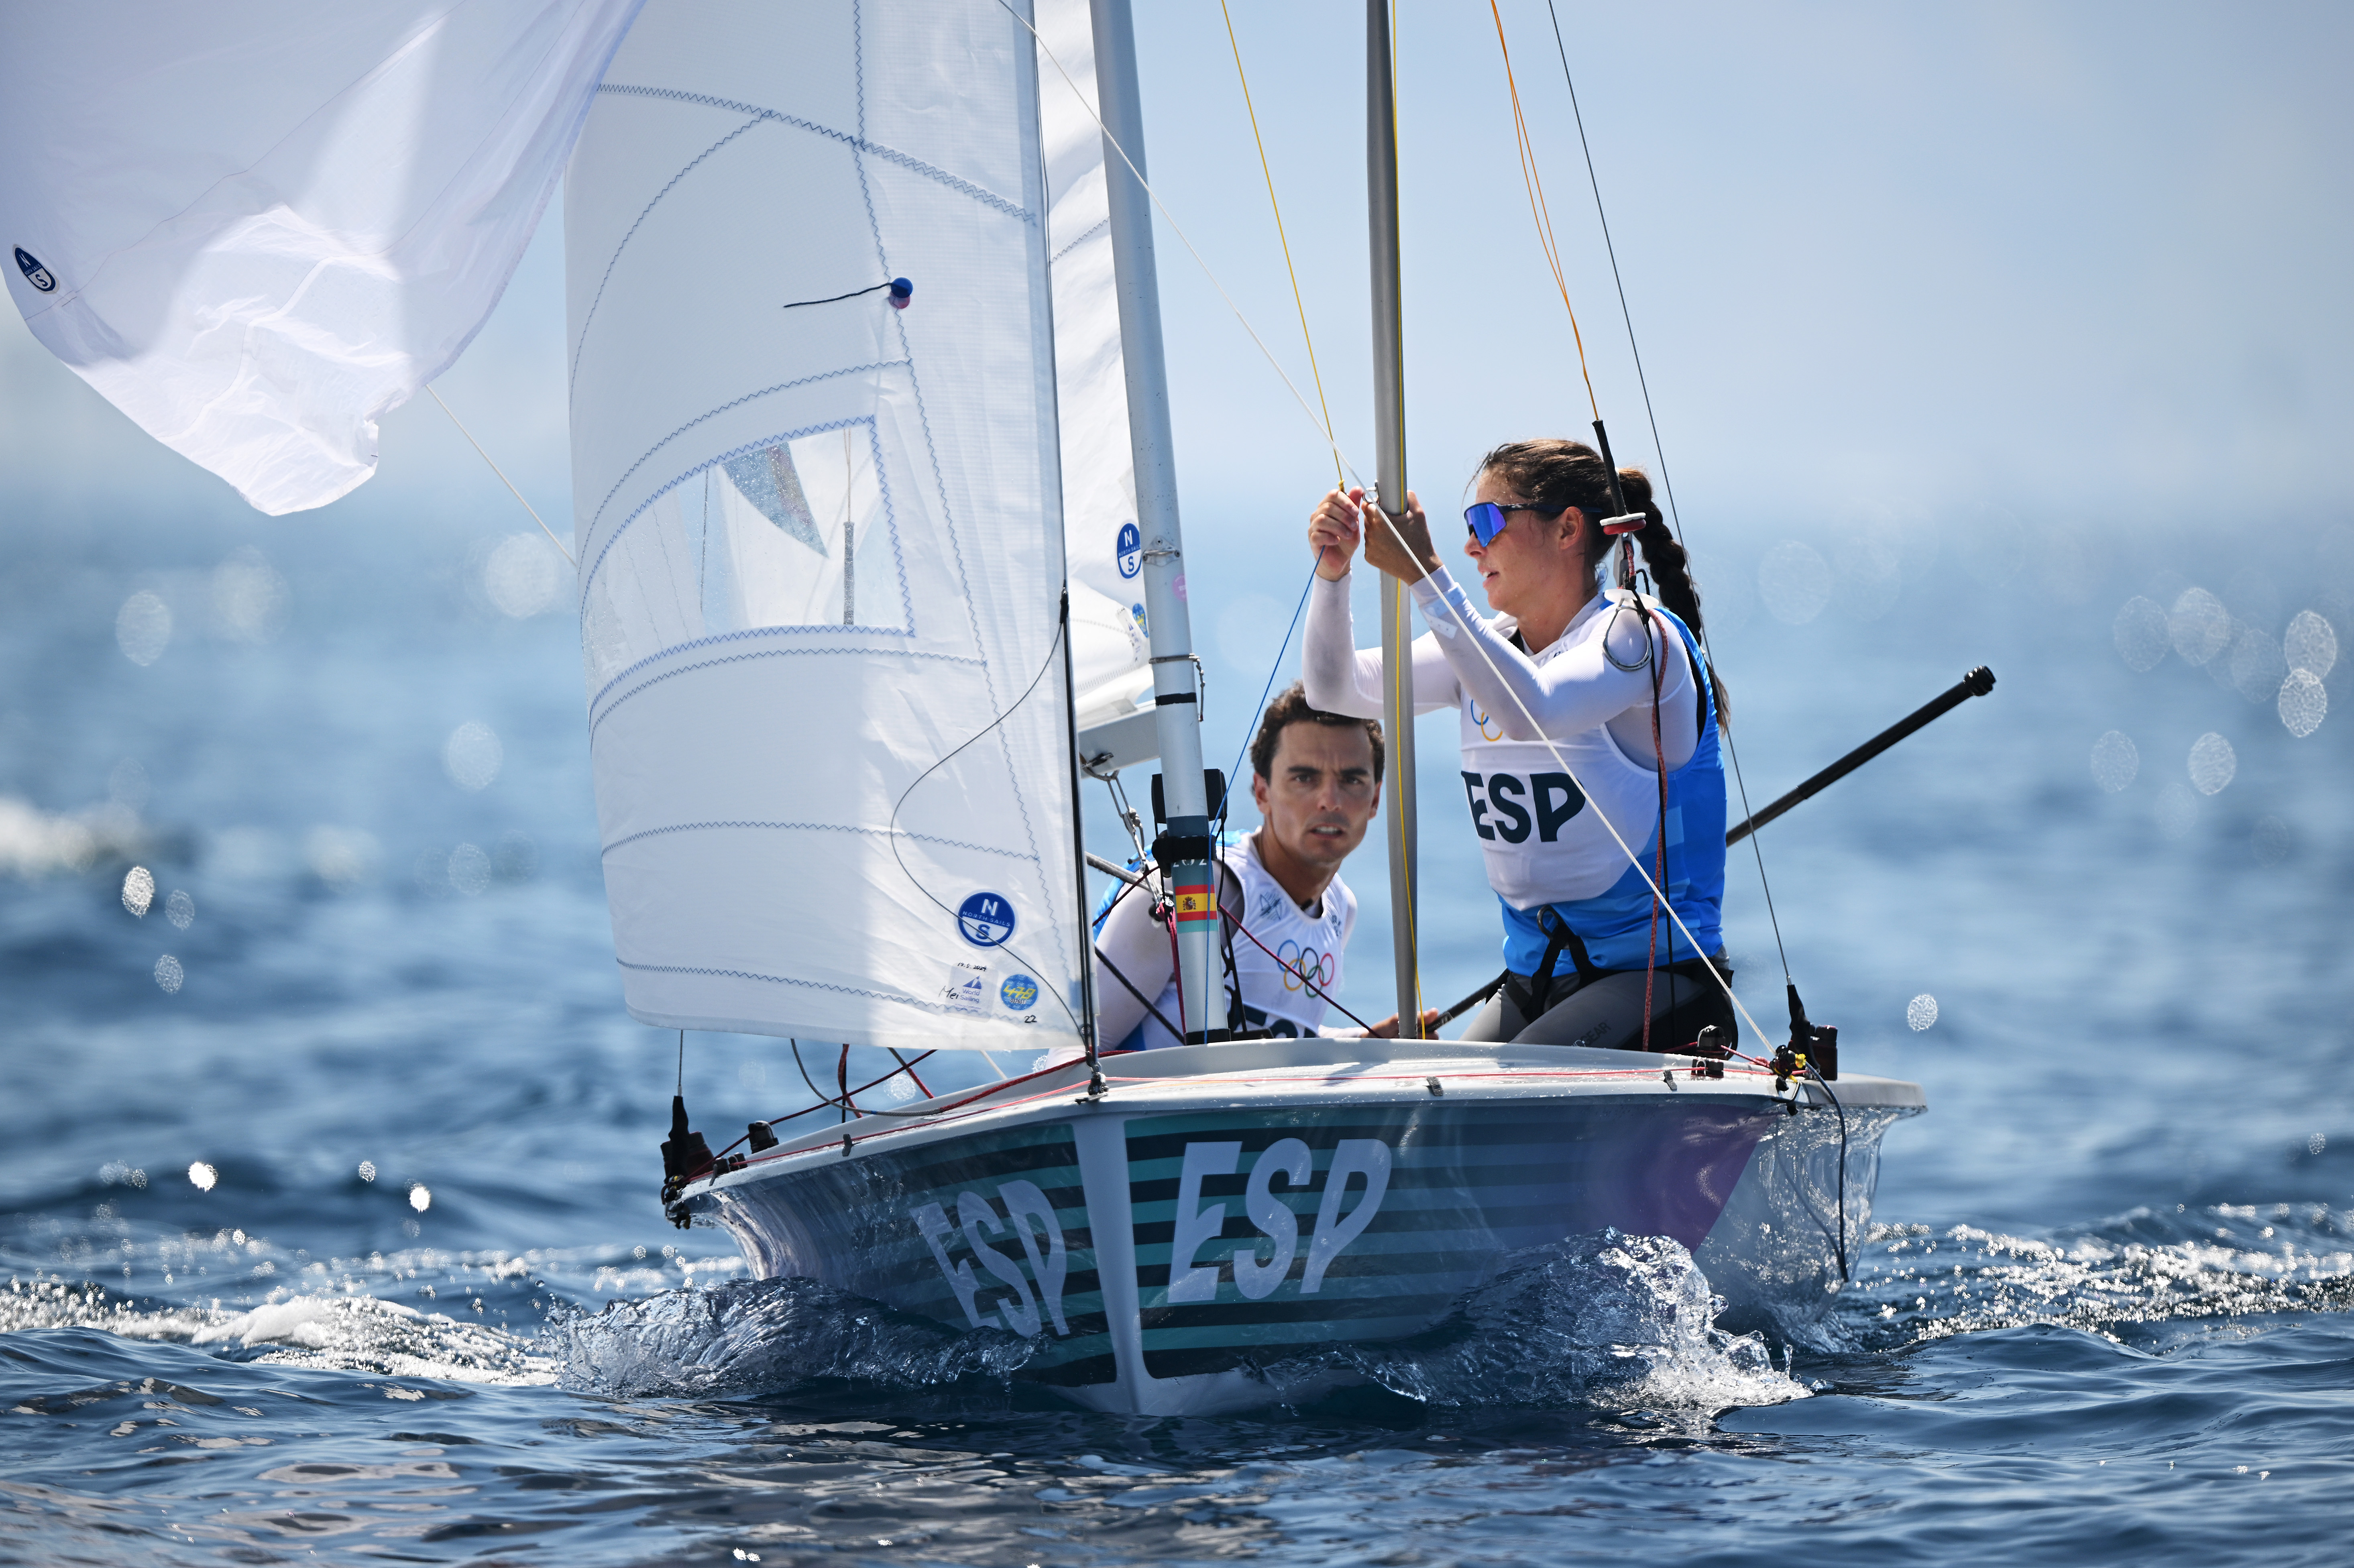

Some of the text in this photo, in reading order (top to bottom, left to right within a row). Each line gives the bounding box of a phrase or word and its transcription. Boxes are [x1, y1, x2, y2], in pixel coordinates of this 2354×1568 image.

[19, 253, 31, 267] N
[35, 274, 48, 287] S
[1124, 529, 1133, 546] N
[1128, 556, 1134, 572] S
[1461, 770, 1586, 844] ESP
[981, 898, 998, 916] N
[963, 911, 1011, 927] NORTH SAILS
[975, 923, 991, 939] S
[960, 994, 979, 1003] Sailing
[963, 988, 980, 996] World
[1024, 1014, 1037, 1023] 22
[1167, 1137, 1392, 1303] ESP
[909, 1179, 1071, 1339] ESP
